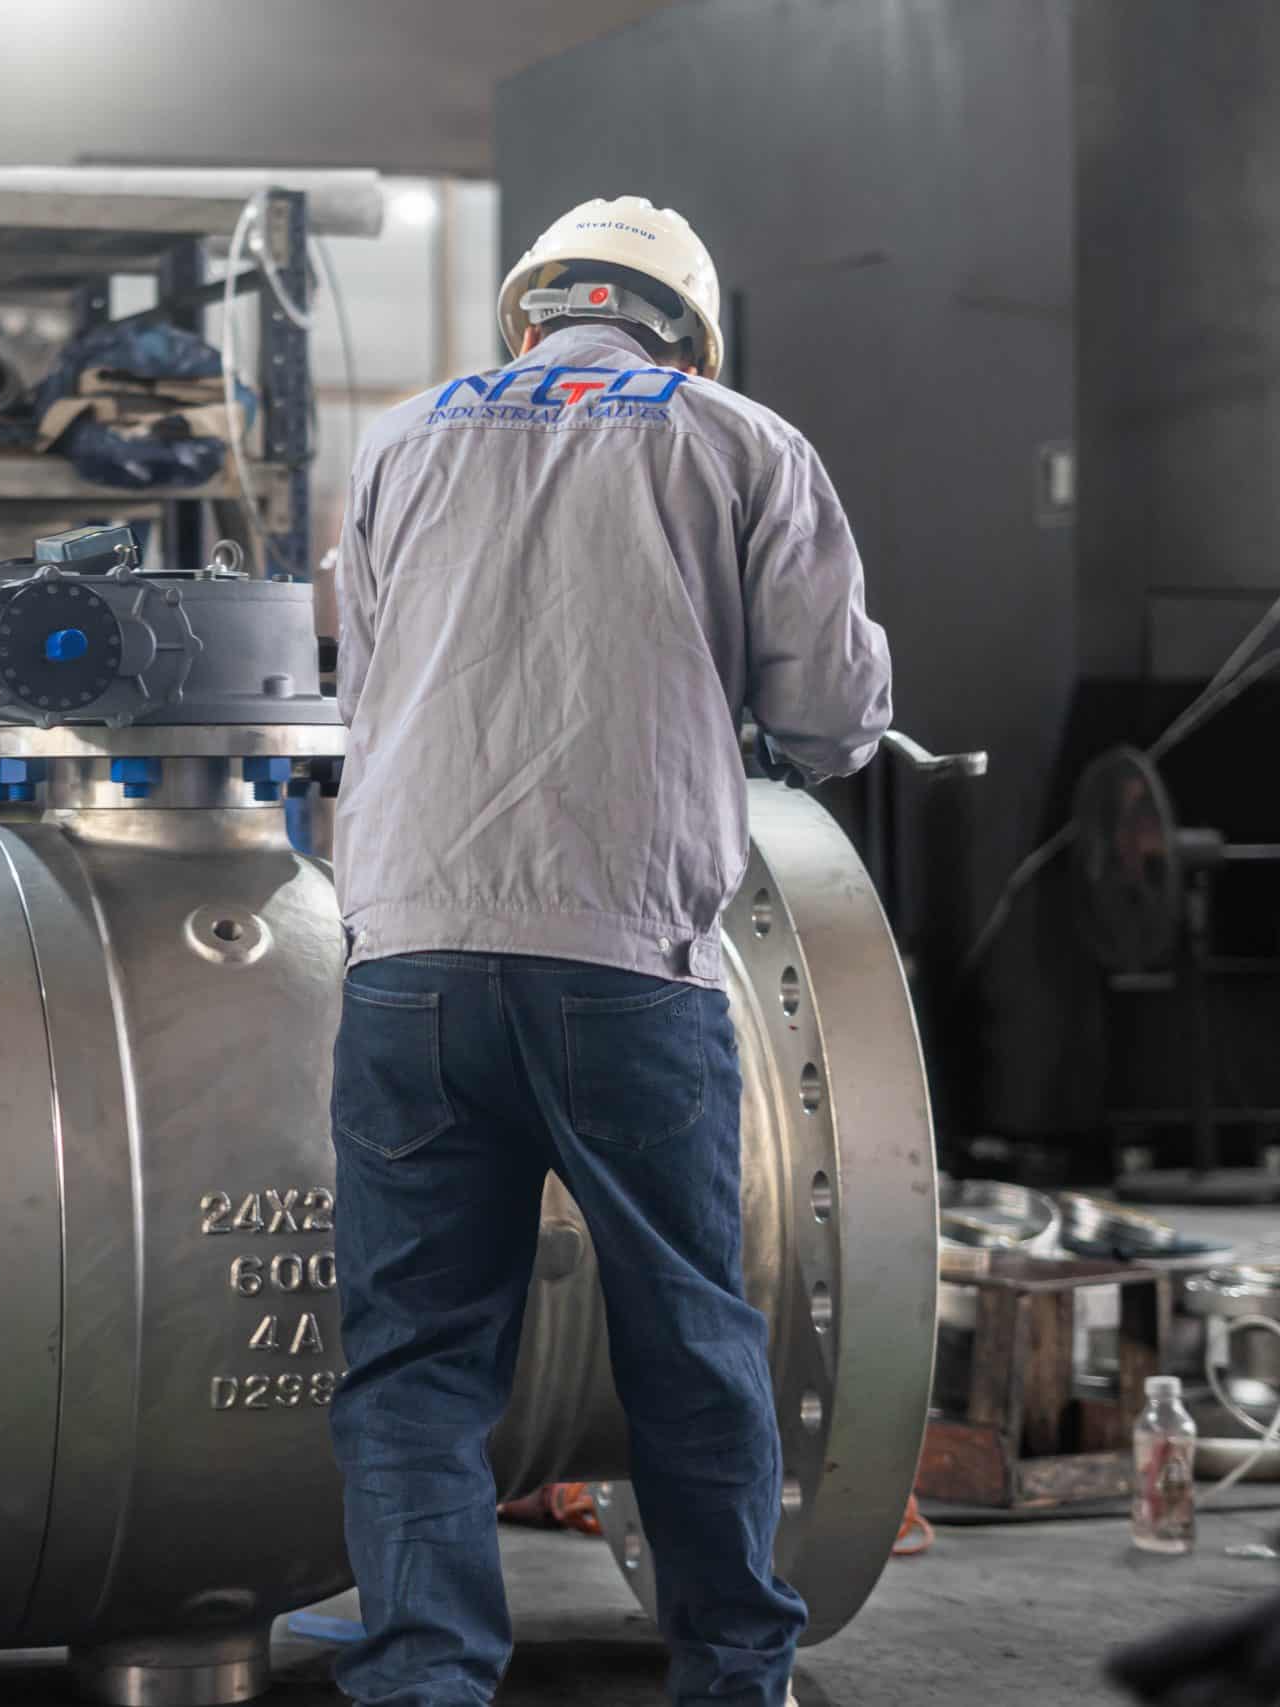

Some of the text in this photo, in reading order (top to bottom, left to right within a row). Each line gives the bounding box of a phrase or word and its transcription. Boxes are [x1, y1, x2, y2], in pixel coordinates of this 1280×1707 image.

[614, 222, 656, 240] Group
[426, 406, 668, 425] INDUSTRIAL VALVES
[230, 1251, 336, 1296] 600
[248, 1312, 324, 1354] 4A
[211, 1369, 347, 1409] D298
